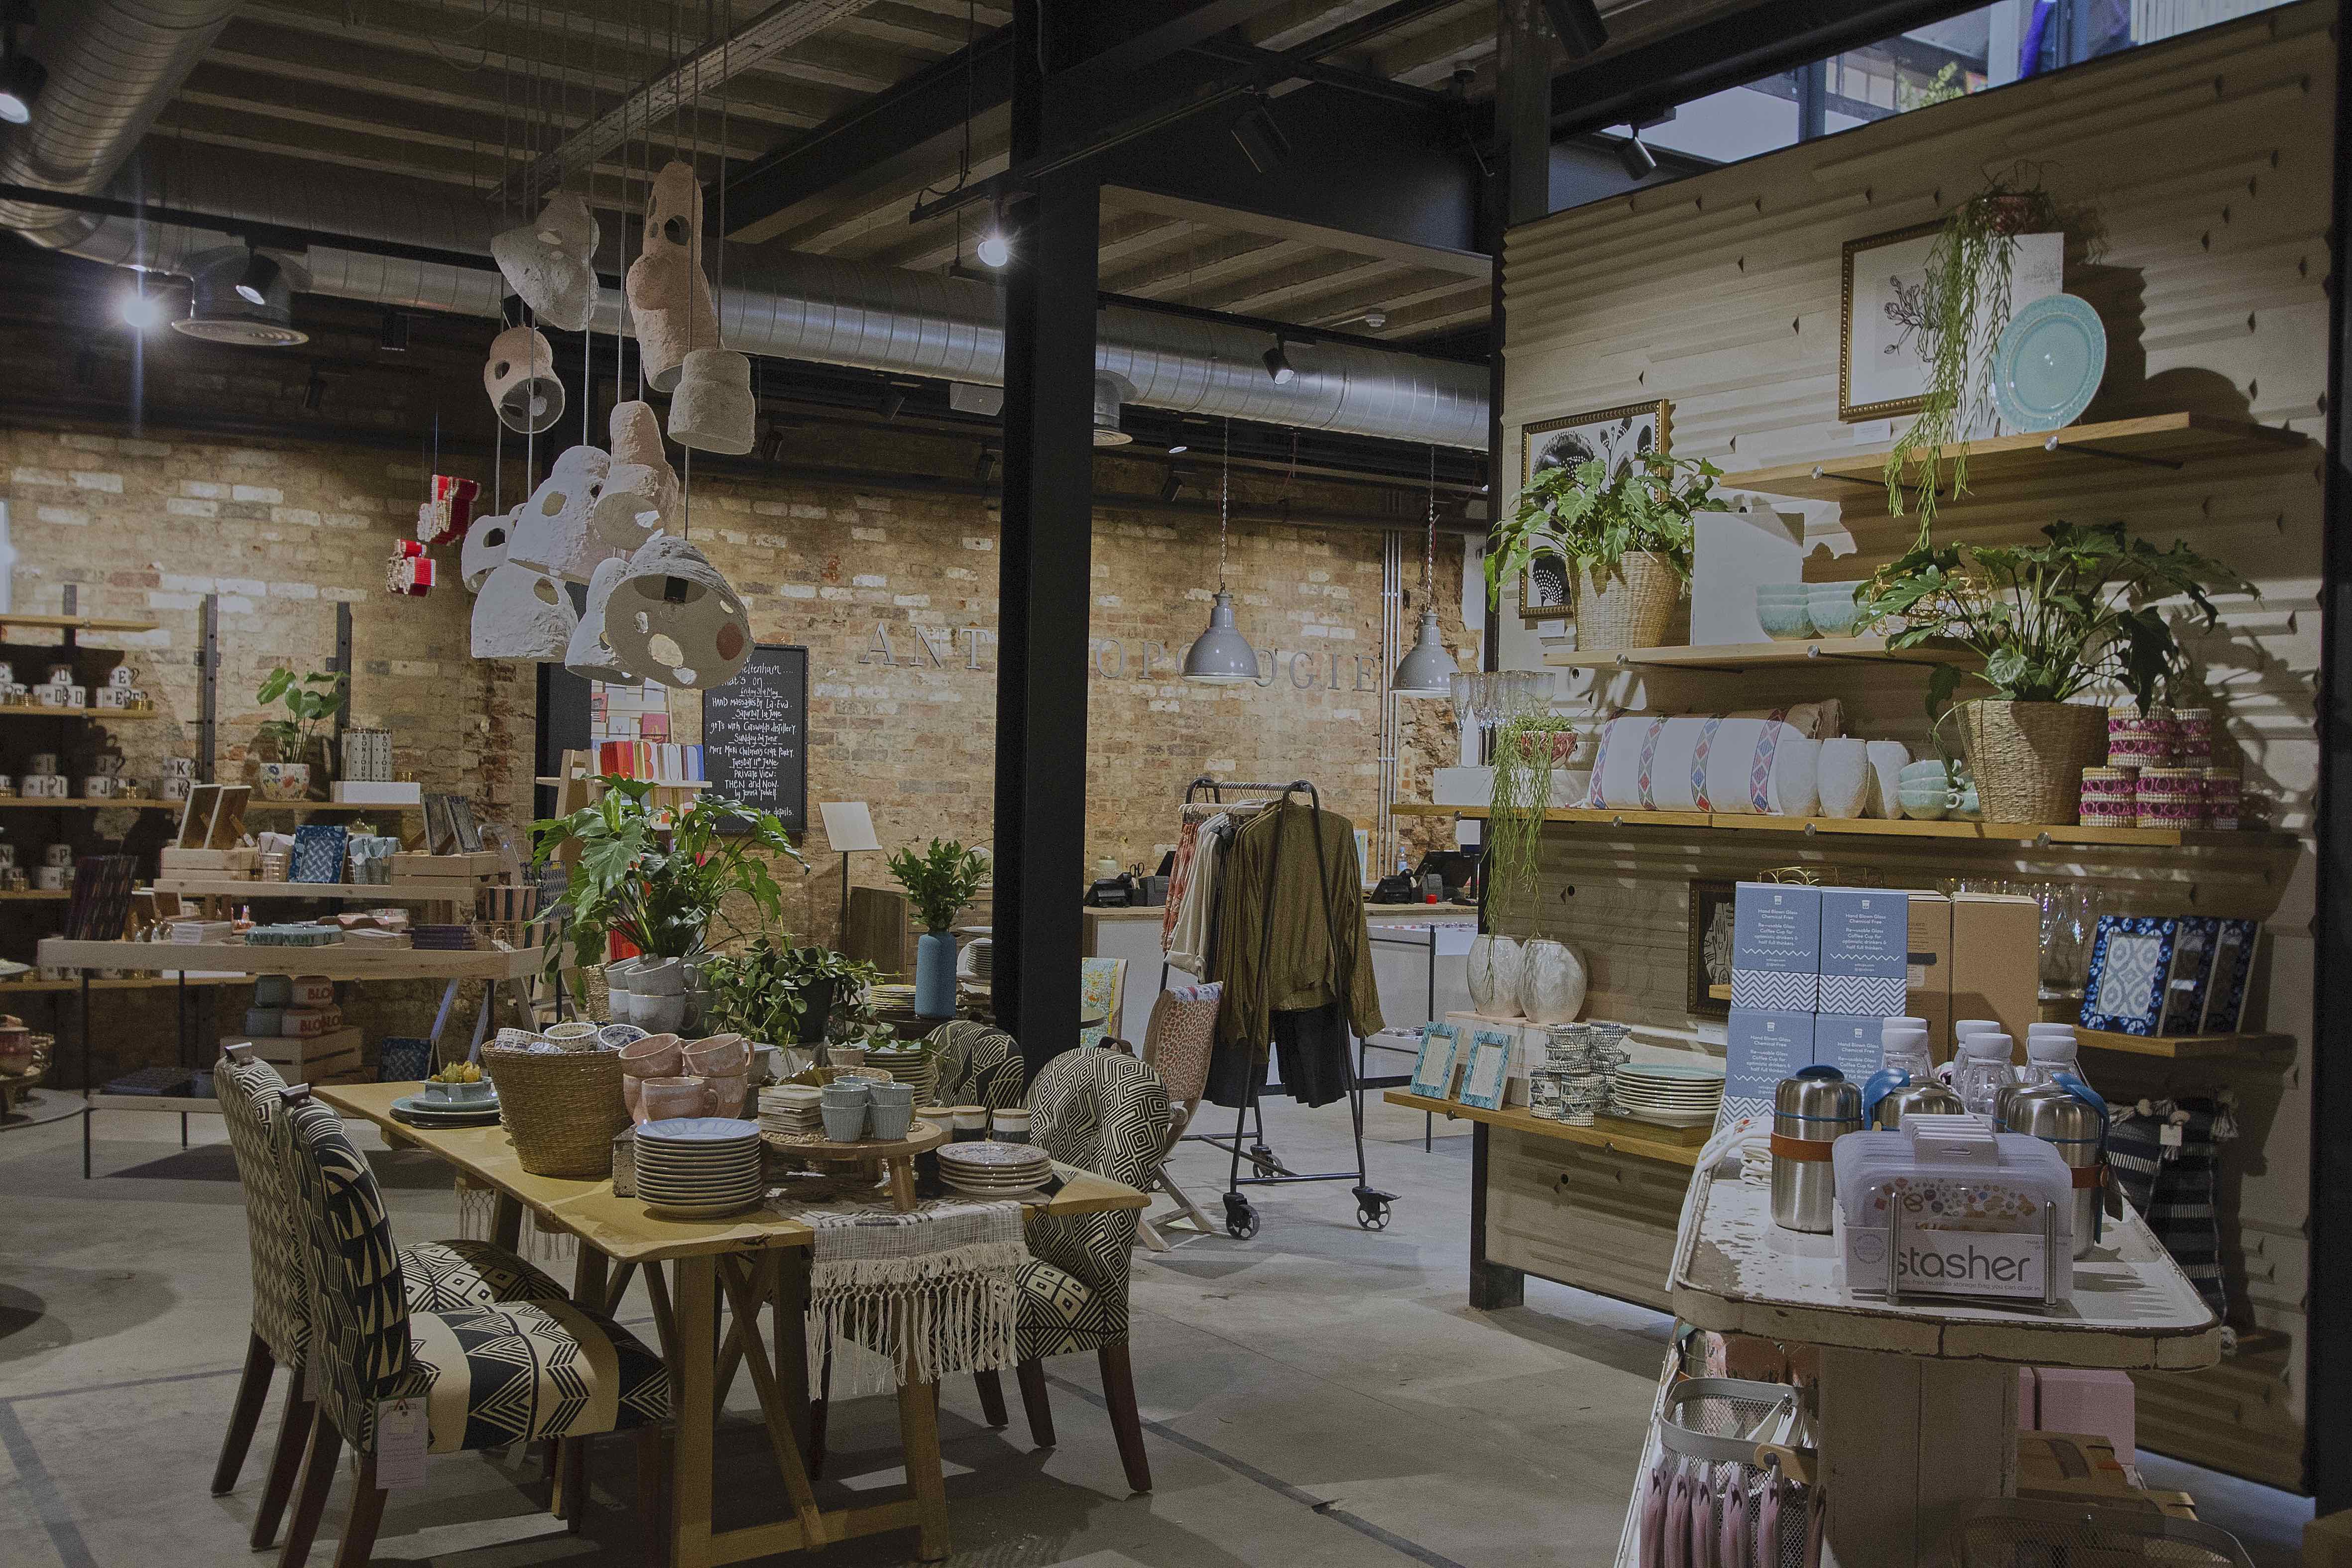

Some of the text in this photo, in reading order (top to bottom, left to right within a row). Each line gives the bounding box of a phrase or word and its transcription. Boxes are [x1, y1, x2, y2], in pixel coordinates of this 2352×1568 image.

[767, 687, 778, 699] May
[177, 761, 185, 774] K
[668, 744, 679, 781] C
[178, 783, 185, 796] K
[748, 779, 761, 790] and
[734, 789, 740, 800] by
